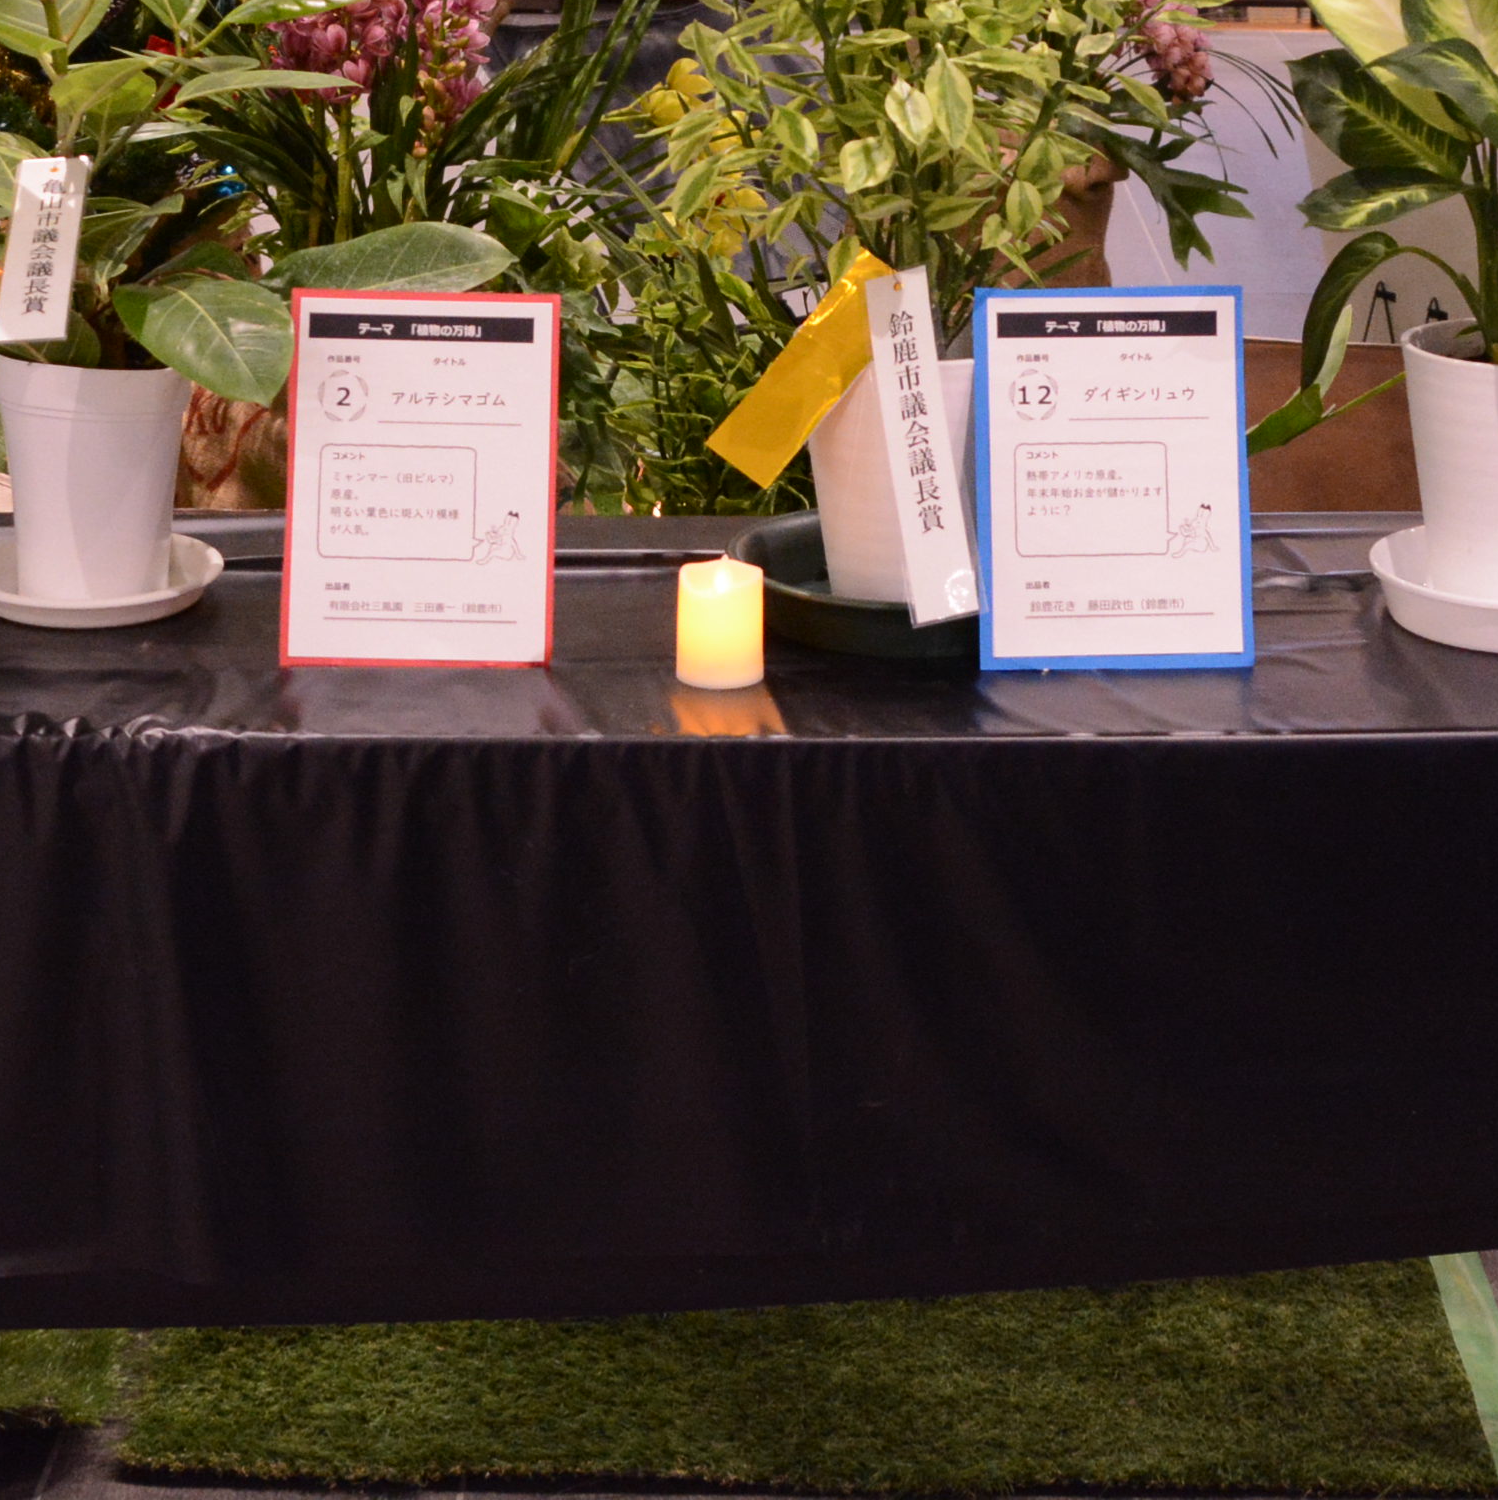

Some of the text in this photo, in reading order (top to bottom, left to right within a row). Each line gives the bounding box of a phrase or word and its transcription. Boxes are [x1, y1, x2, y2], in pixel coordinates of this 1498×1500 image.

[21, 179, 66, 315] 亀山市議会議長賞
[358, 323, 483, 338] テーマ 「植物の万博」
[1046, 319, 1166, 333] テーマ 「植物の万博」
[433, 358, 466, 367] タイトル
[1120, 353, 1152, 362] タイトル
[337, 387, 506, 407] 2 アルテシマゴム
[1017, 385, 1195, 405] 12 ダイギンリュウ
[888, 310, 945, 534] 鈴鹿市議会議長賞
[333, 452, 365, 460] コメント
[1026, 451, 1059, 459] コメント
